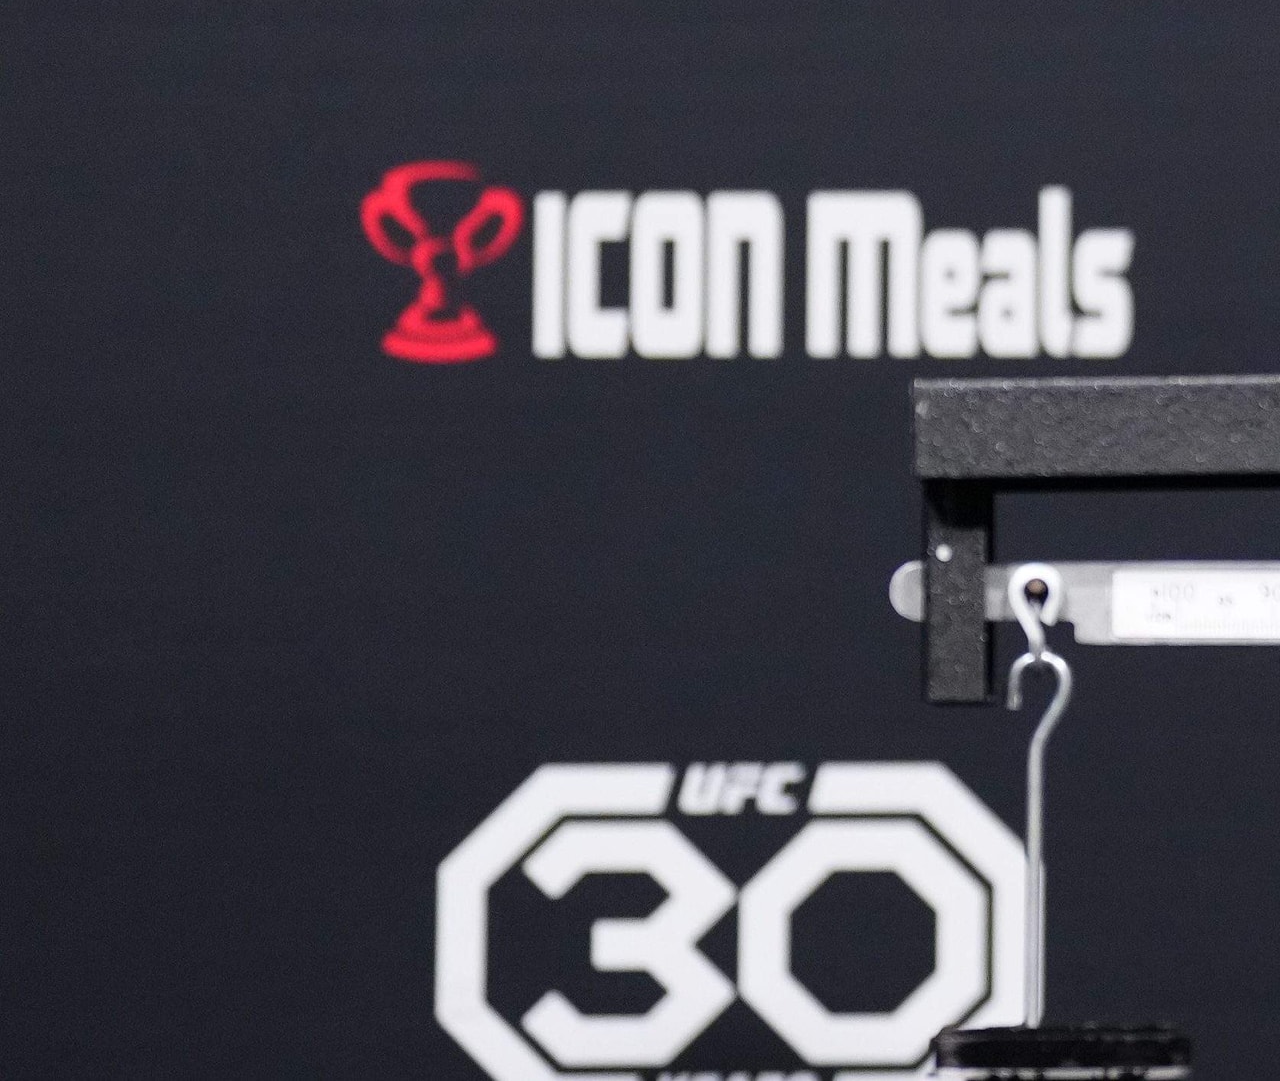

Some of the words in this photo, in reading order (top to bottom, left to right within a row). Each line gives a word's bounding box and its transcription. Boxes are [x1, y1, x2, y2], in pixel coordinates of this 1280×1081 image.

[532, 189, 785, 359] ICON
[805, 184, 1135, 359] Meals
[678, 762, 804, 814] UFC
[521, 819, 989, 1068] 30
